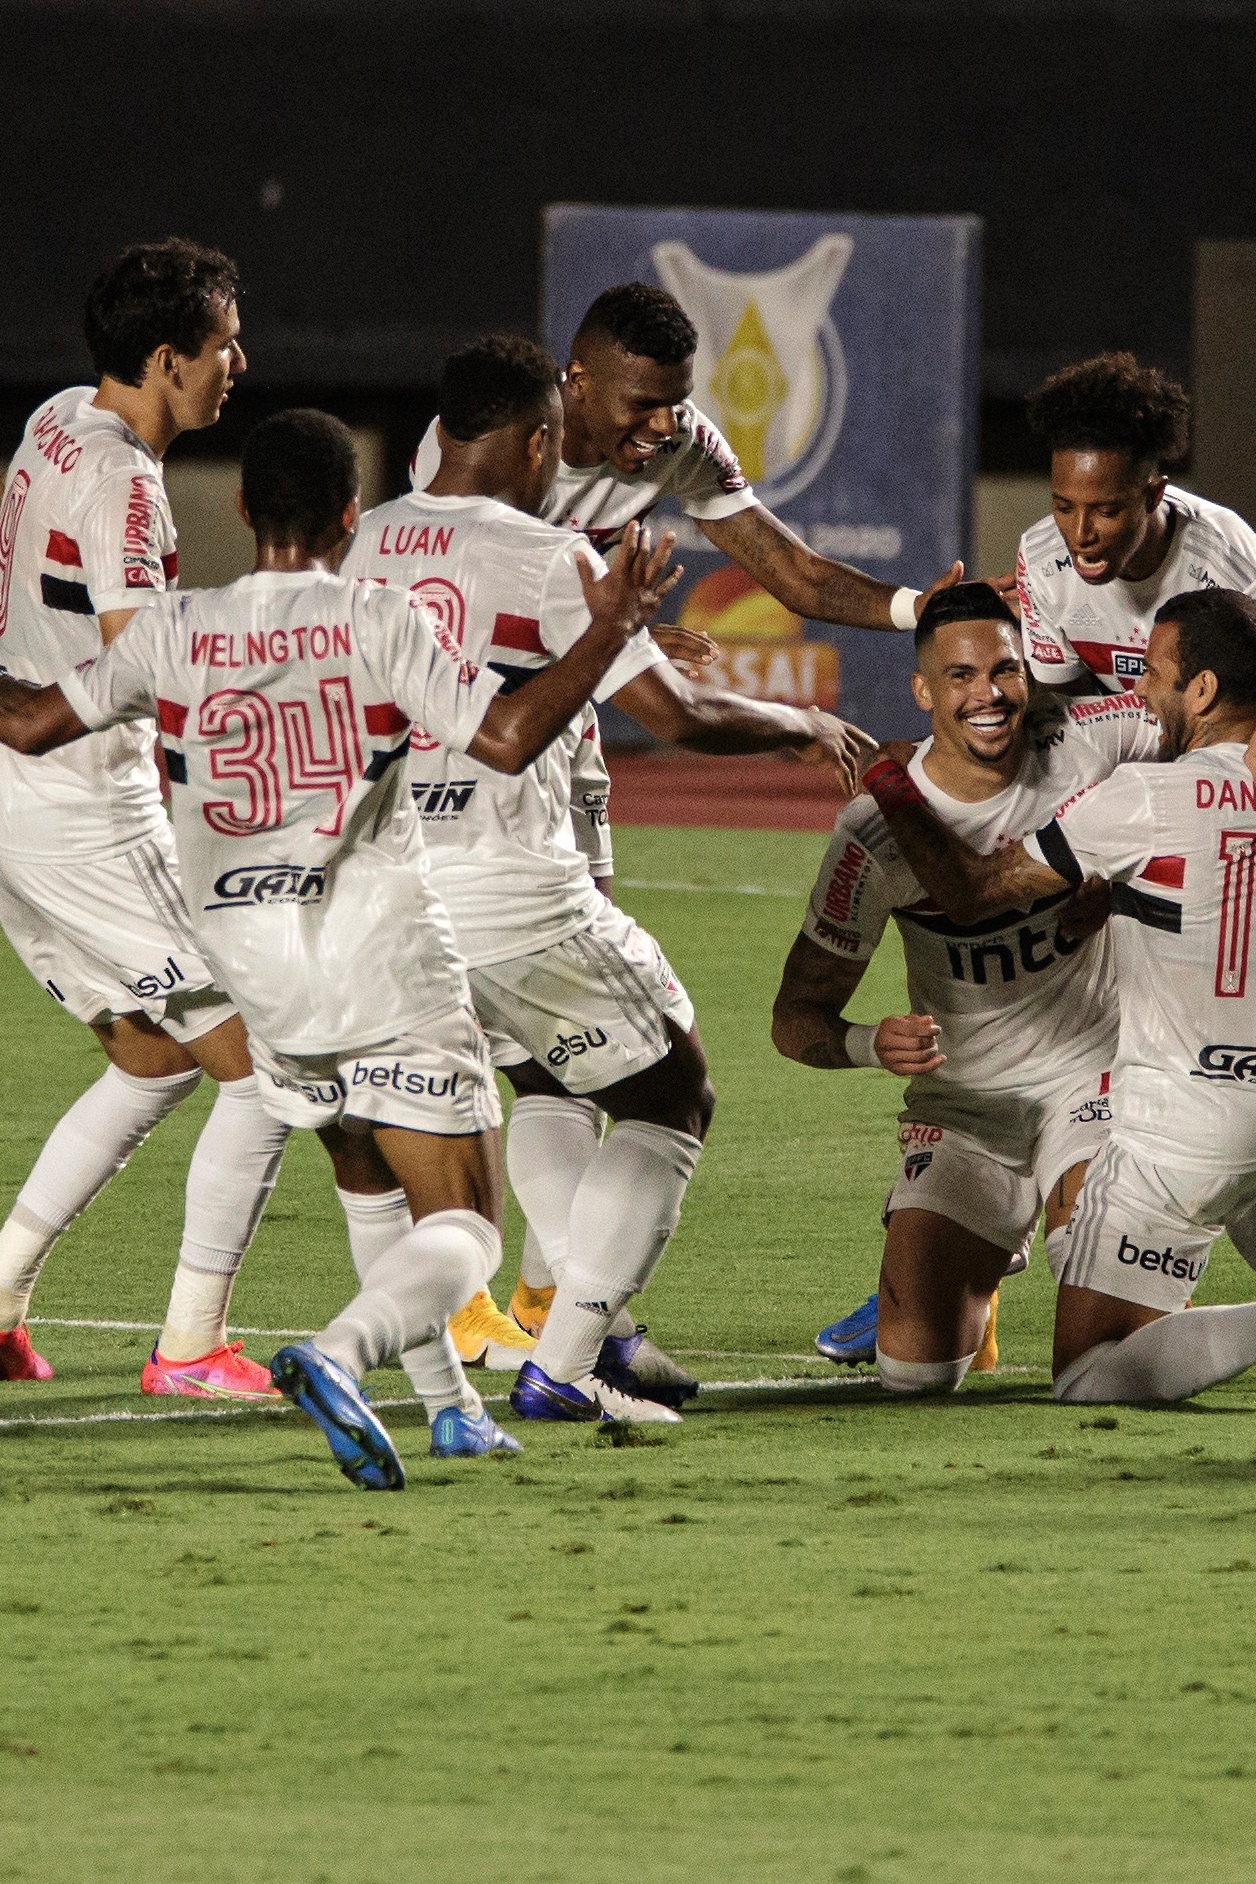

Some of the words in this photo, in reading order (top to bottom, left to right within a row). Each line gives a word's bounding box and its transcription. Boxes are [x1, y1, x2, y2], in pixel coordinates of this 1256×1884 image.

[379, 524, 455, 557] LUAN
[199, 675, 366, 838] 34
[352, 1061, 458, 1098] betsul
[1117, 1234, 1208, 1282] betsu
